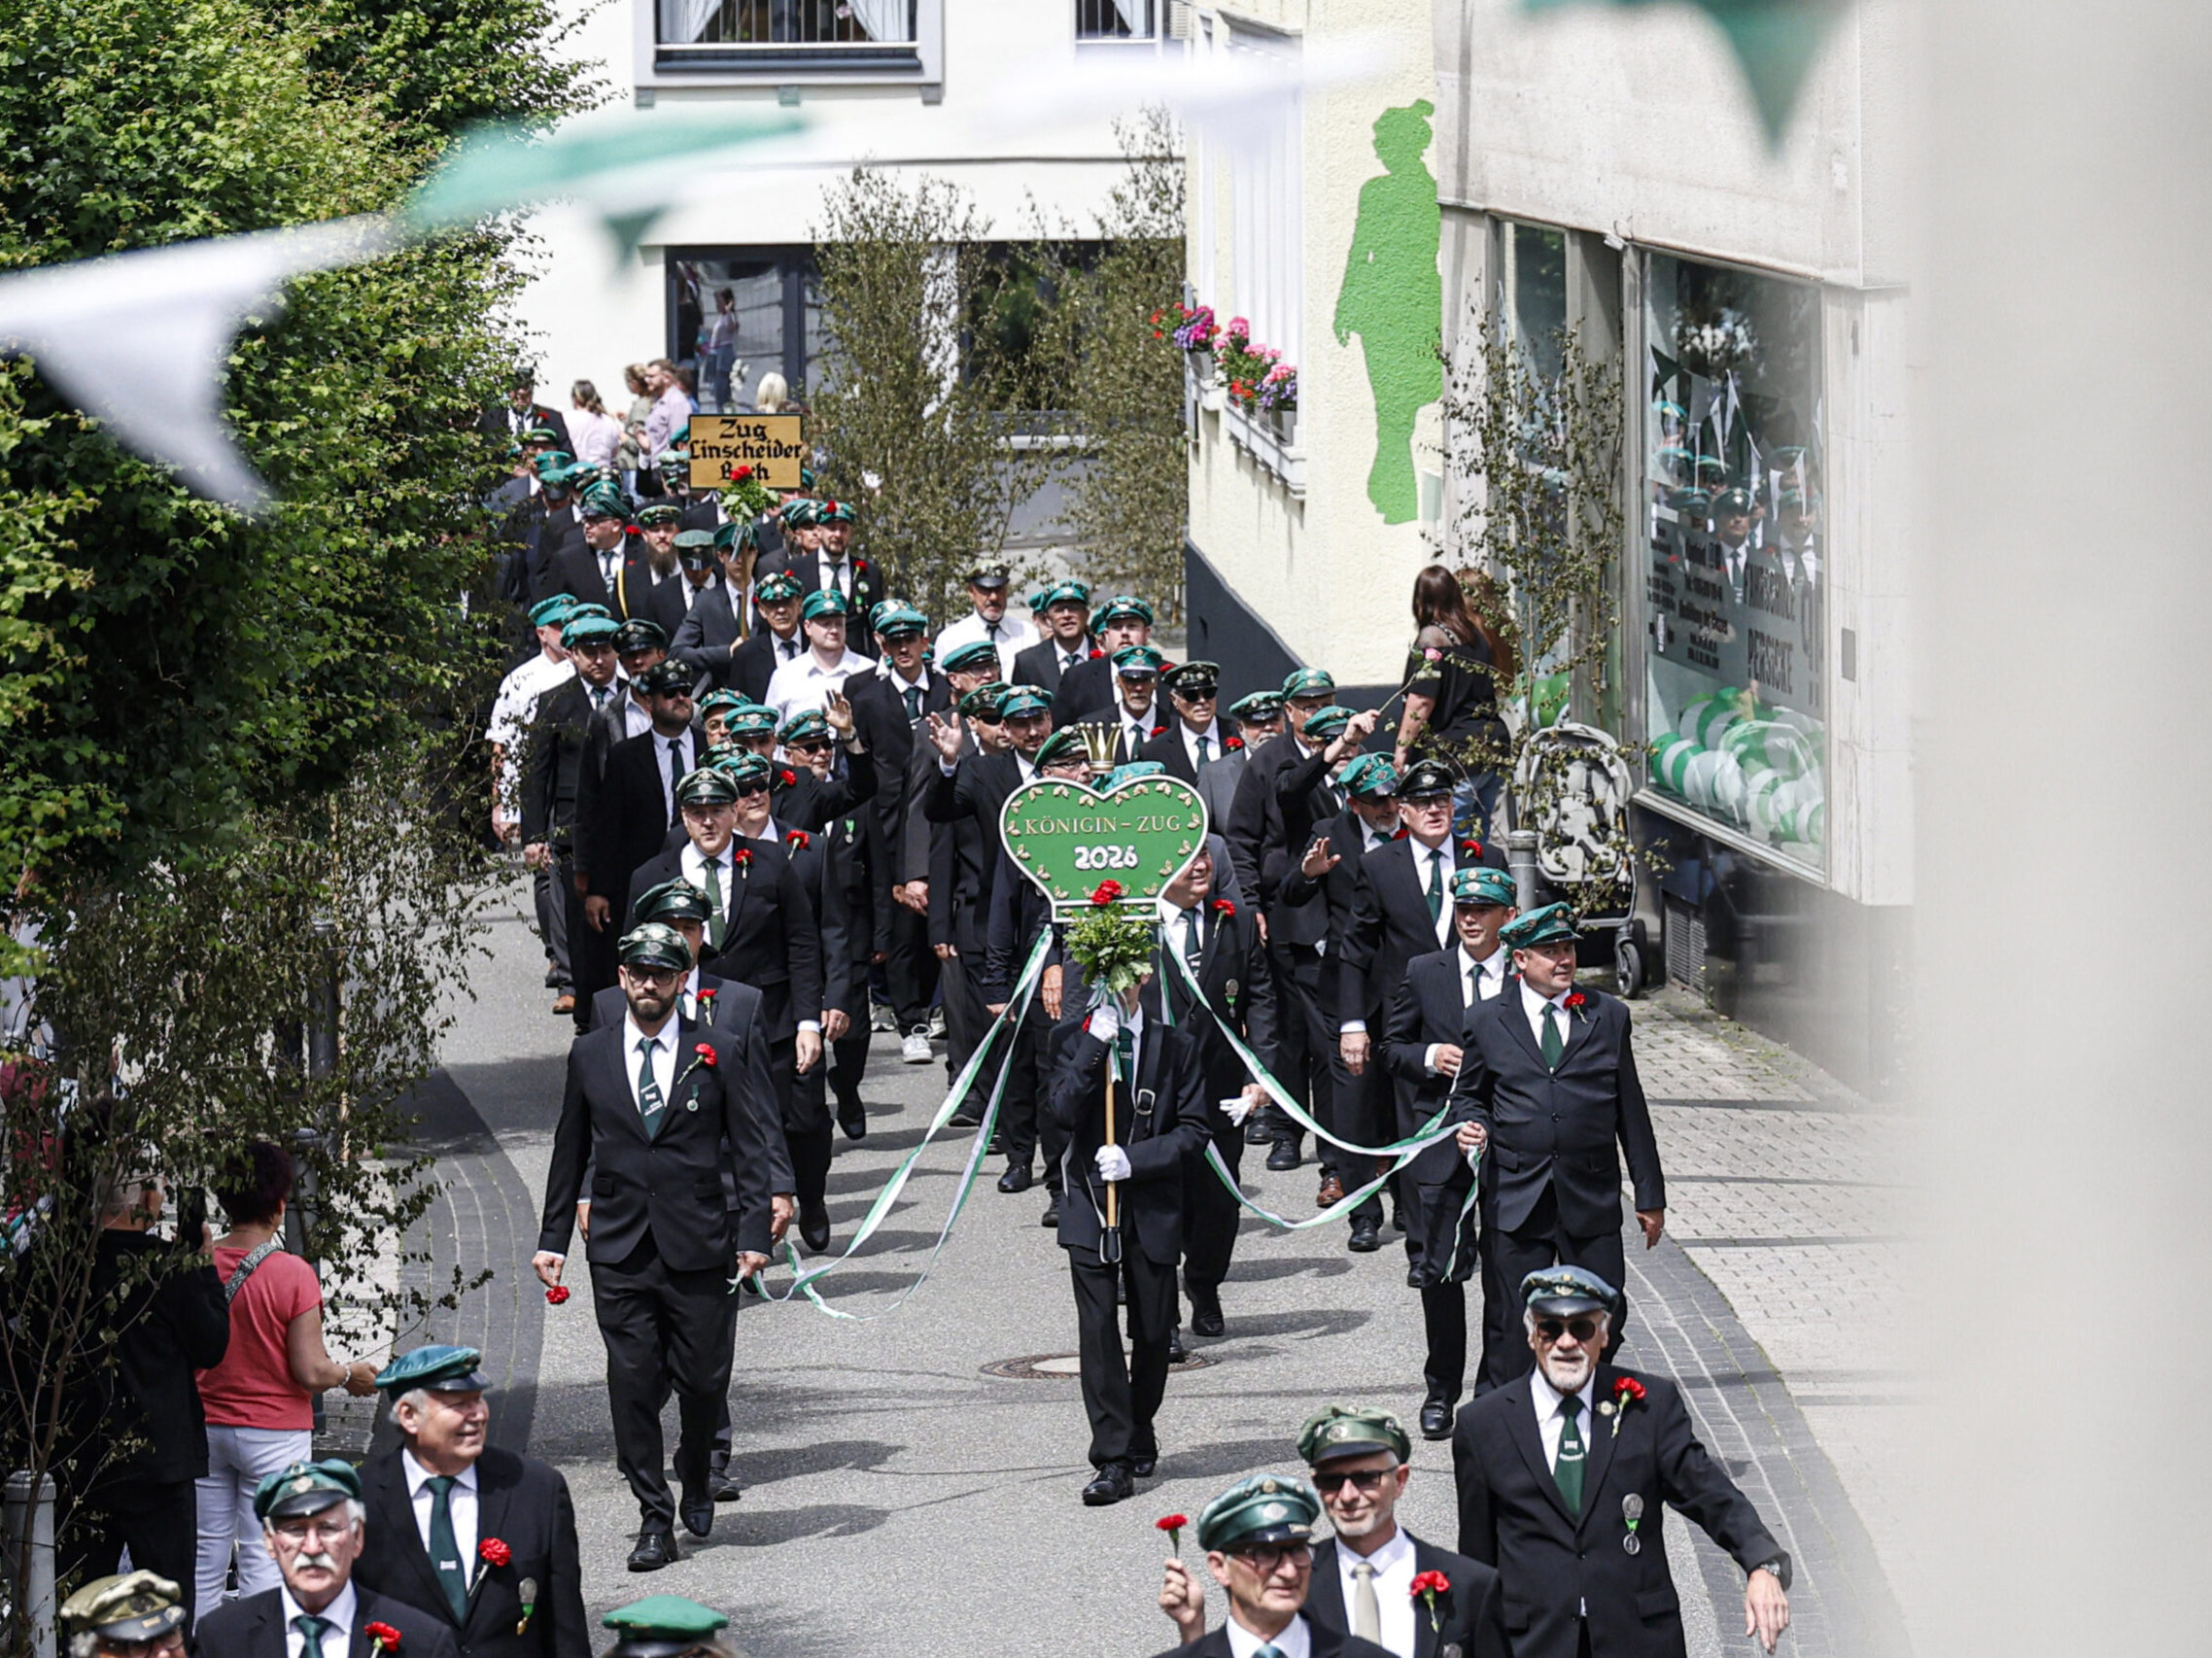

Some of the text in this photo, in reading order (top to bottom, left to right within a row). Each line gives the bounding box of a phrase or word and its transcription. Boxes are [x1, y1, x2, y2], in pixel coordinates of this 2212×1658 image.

[719, 418, 769, 442] Zug
[1024, 815, 1119, 836] KÖNIGIN
[1136, 814, 1182, 833] ZUG
[1073, 844, 1140, 871] 2026
